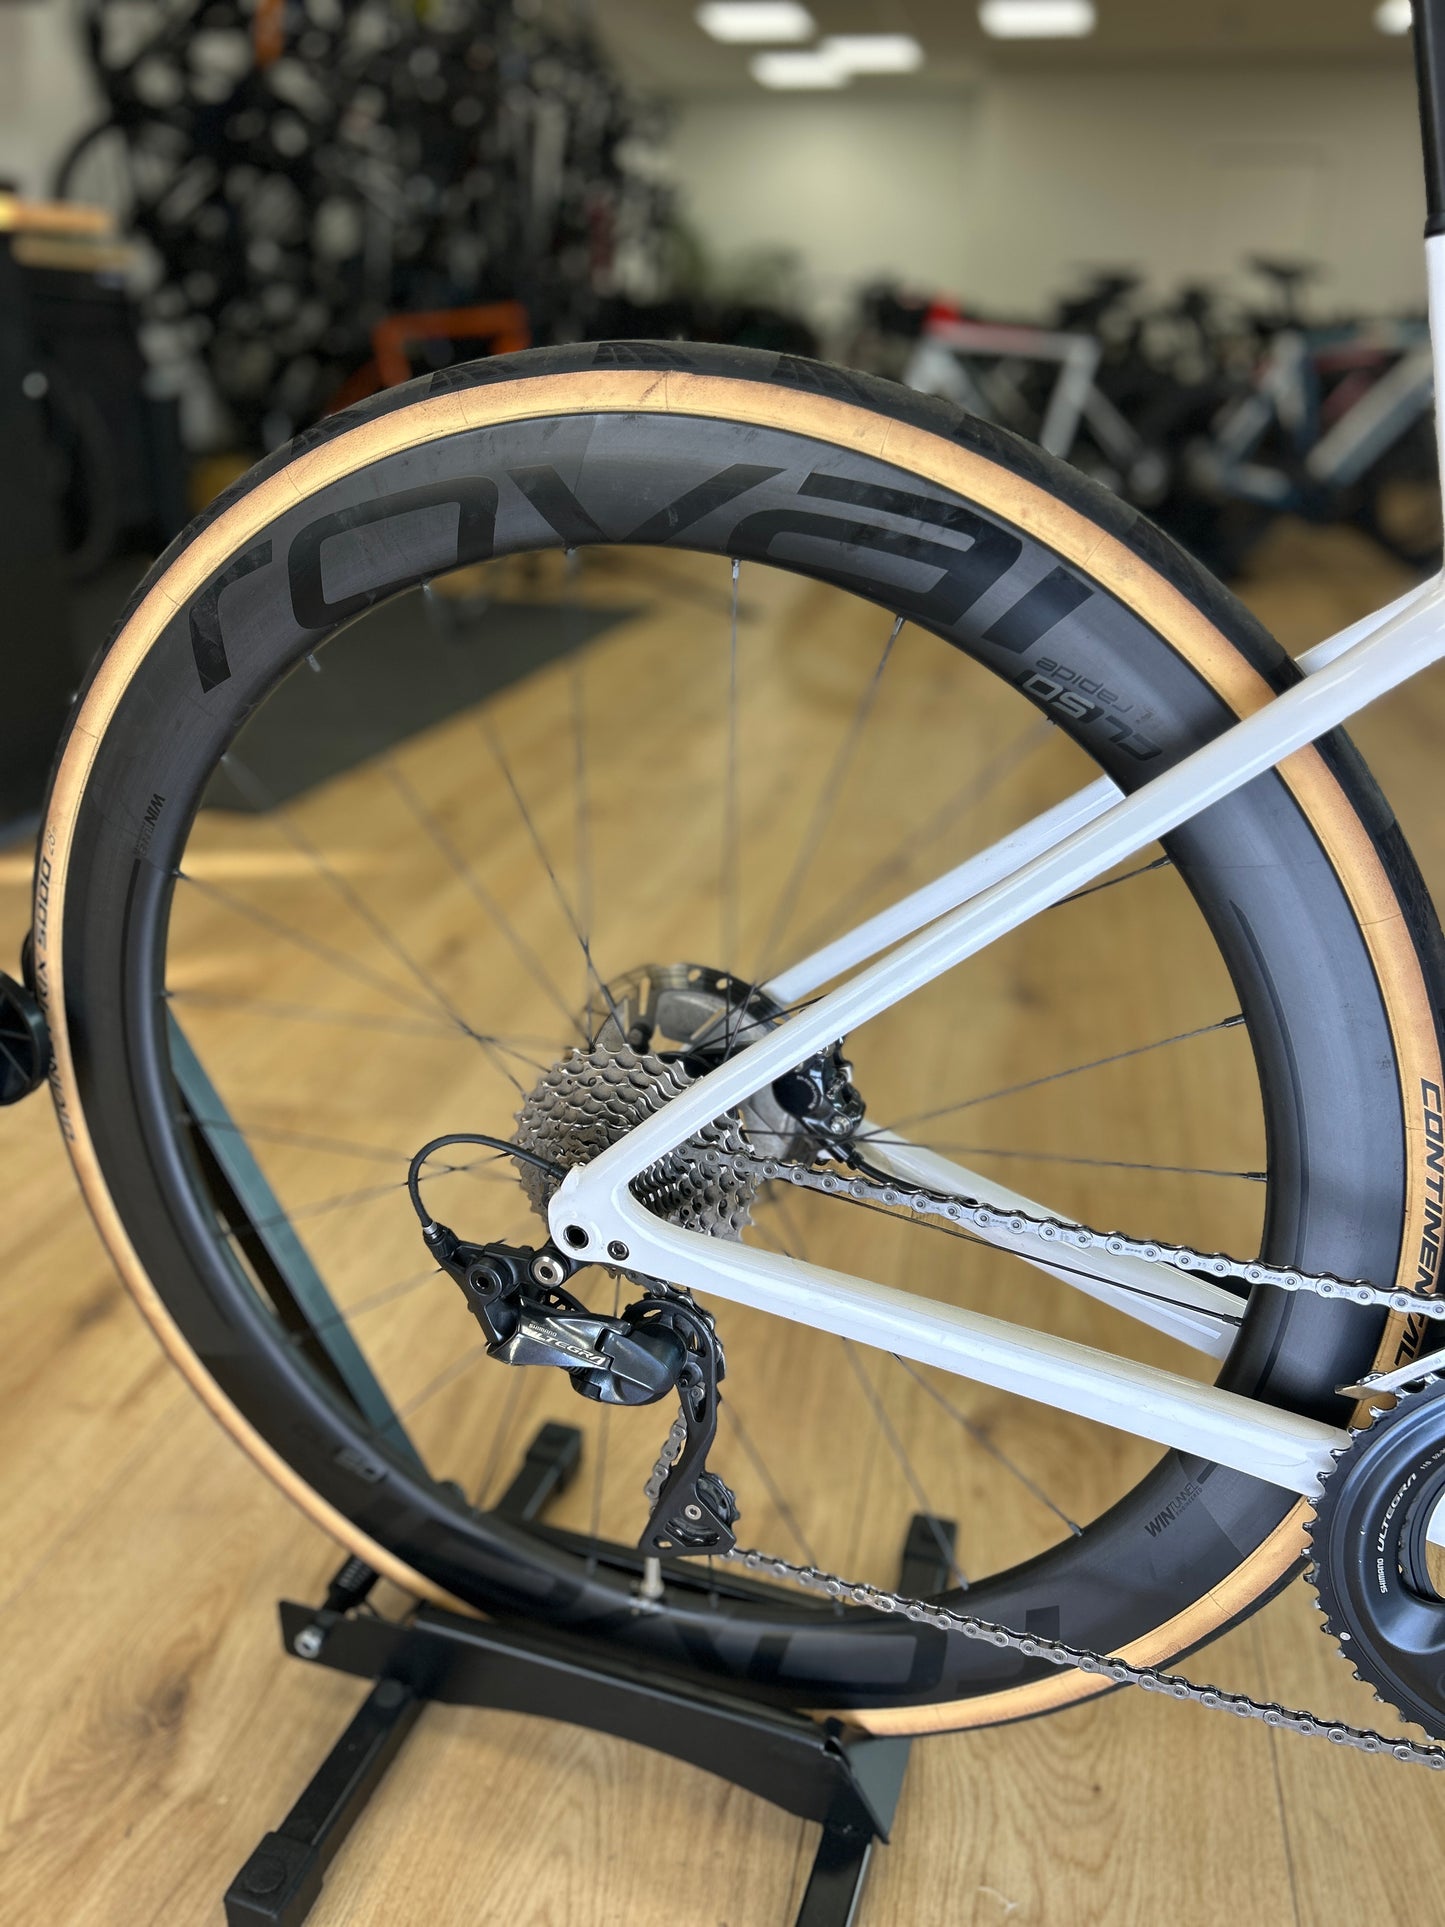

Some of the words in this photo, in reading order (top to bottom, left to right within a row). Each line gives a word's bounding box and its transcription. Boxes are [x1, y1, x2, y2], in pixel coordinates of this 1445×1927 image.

[189, 463, 1095, 694] roval
[1036, 657, 1134, 713] rapide
[1395, 1077, 1445, 1367] CONTINENAL
[1376, 1472, 1418, 1553] ULTEGRA
[1376, 1558, 1389, 1594] SHIMANO
